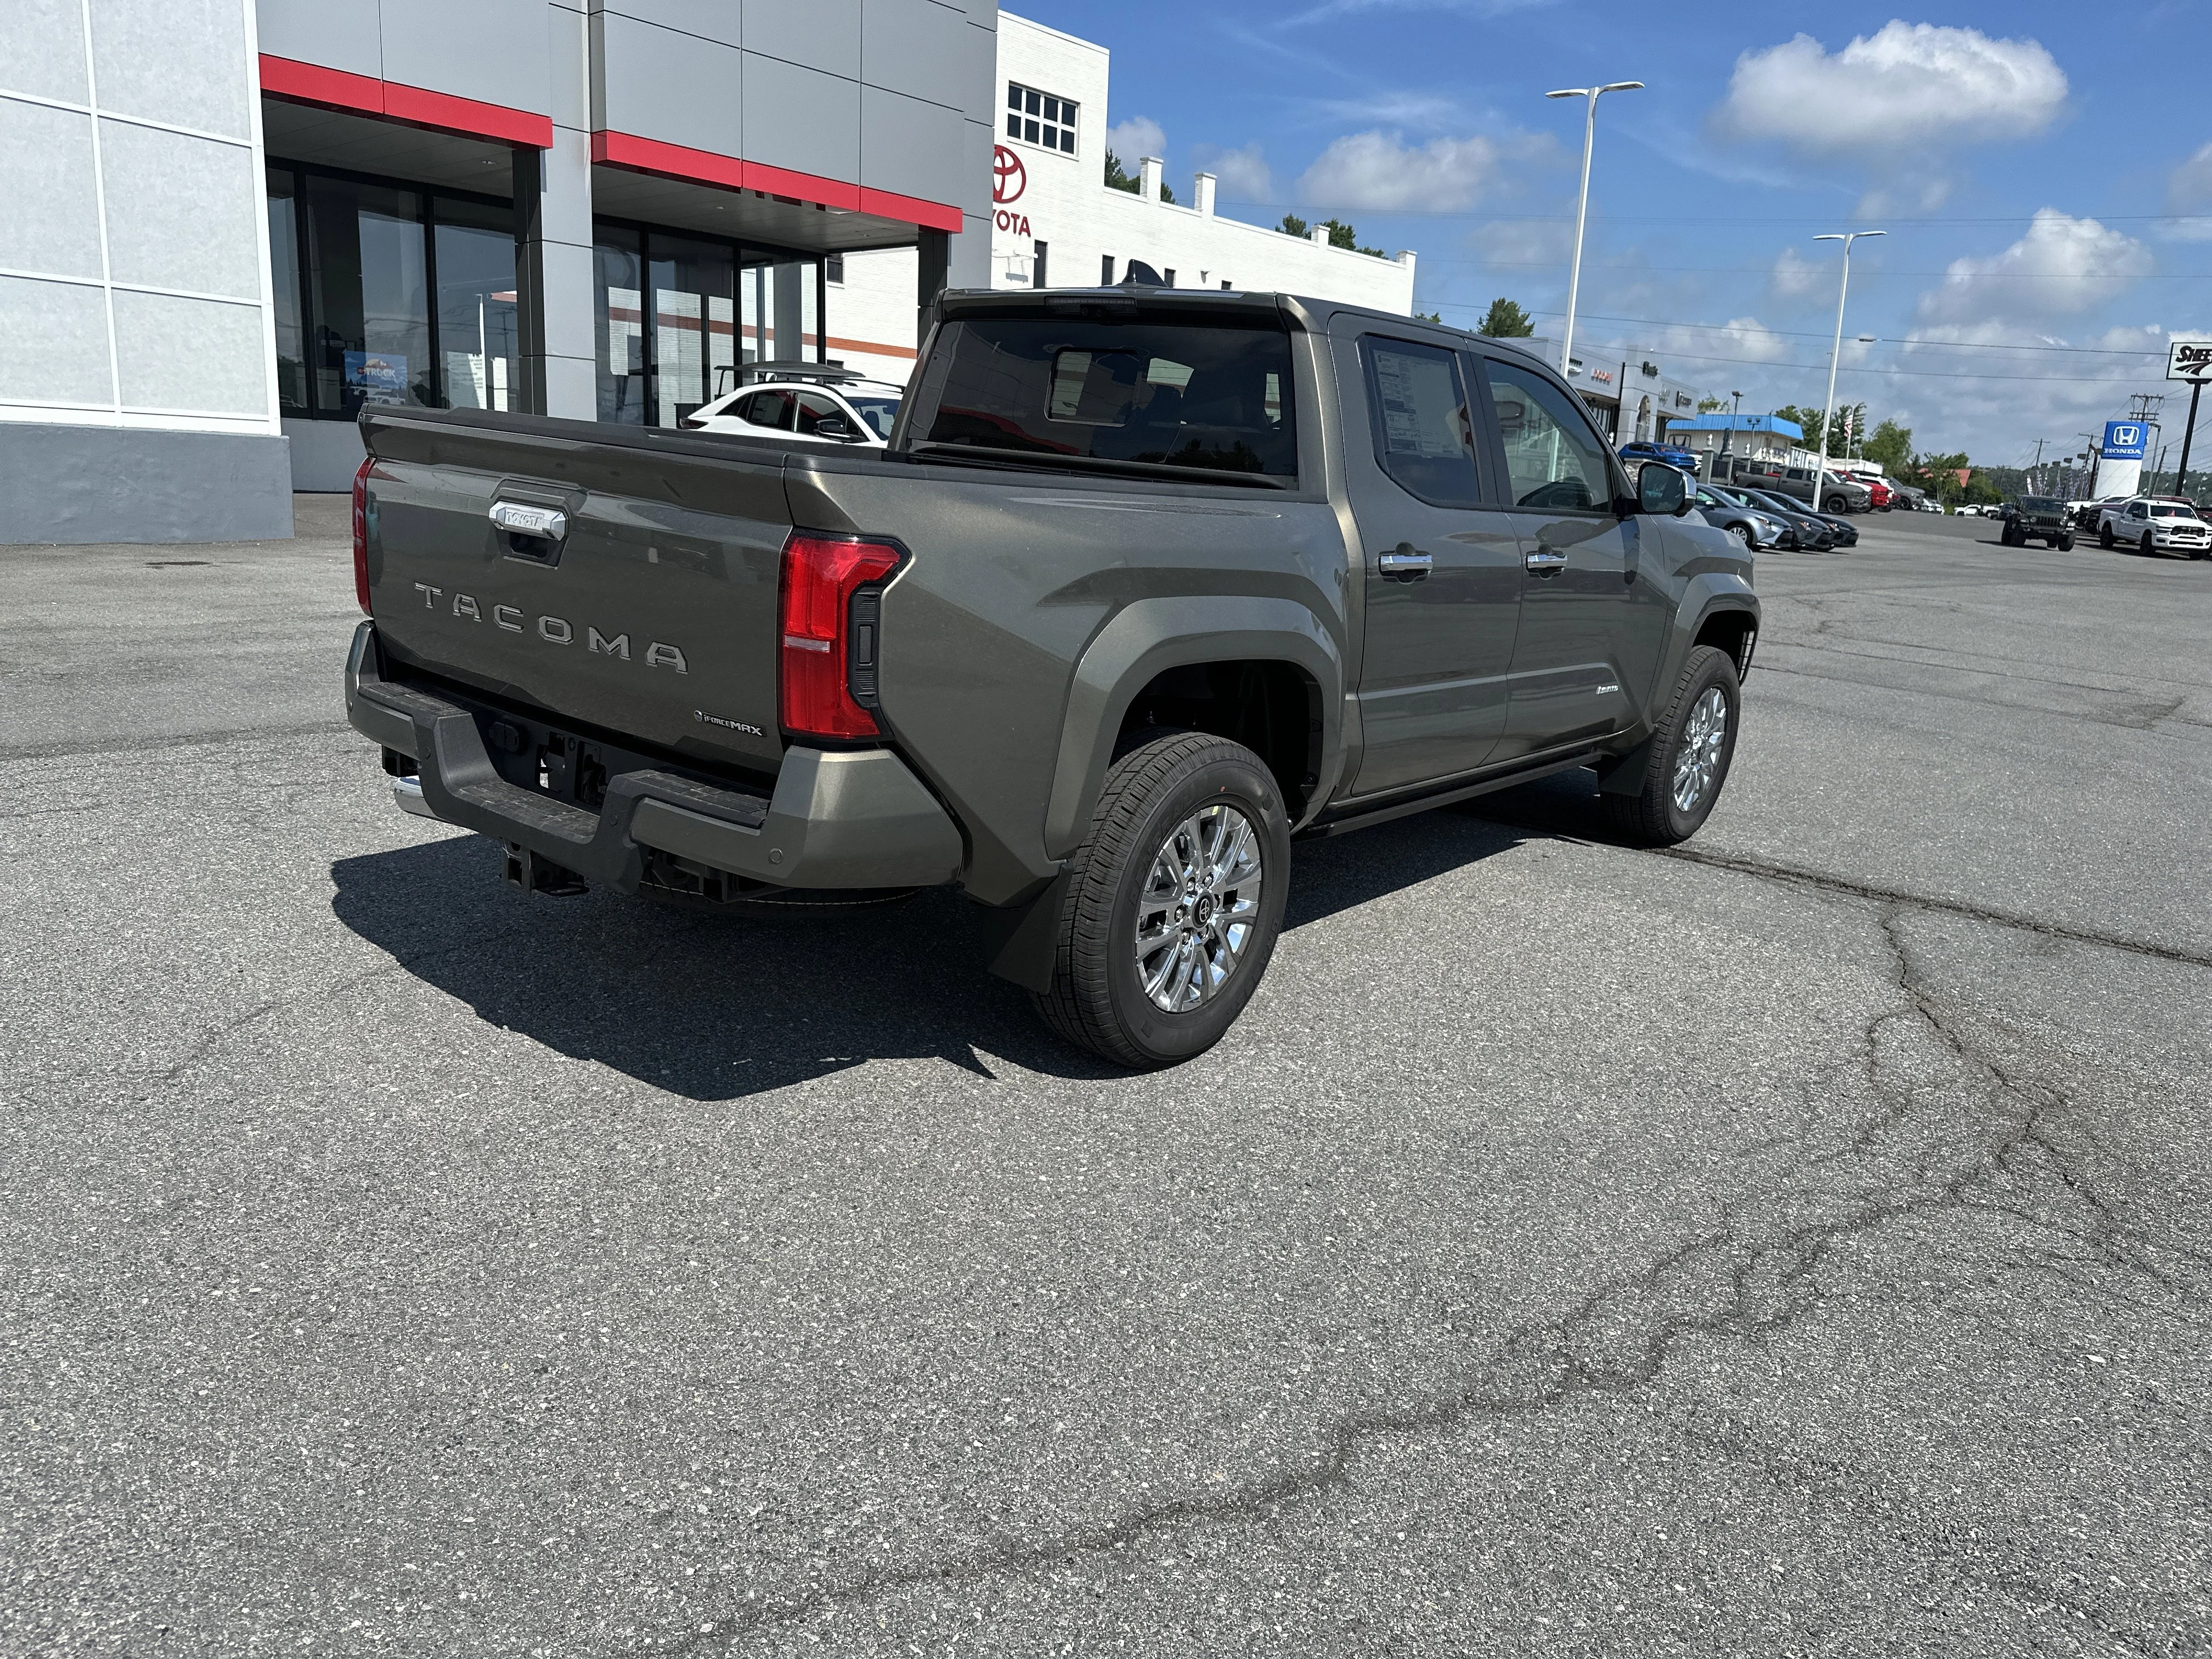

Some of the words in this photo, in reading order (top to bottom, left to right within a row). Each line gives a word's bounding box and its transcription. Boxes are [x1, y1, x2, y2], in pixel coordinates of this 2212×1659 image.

[2175, 346, 2212, 362] SHEE
[506, 511, 543, 528] TOYOTA
[414, 582, 689, 674] TACOMA
